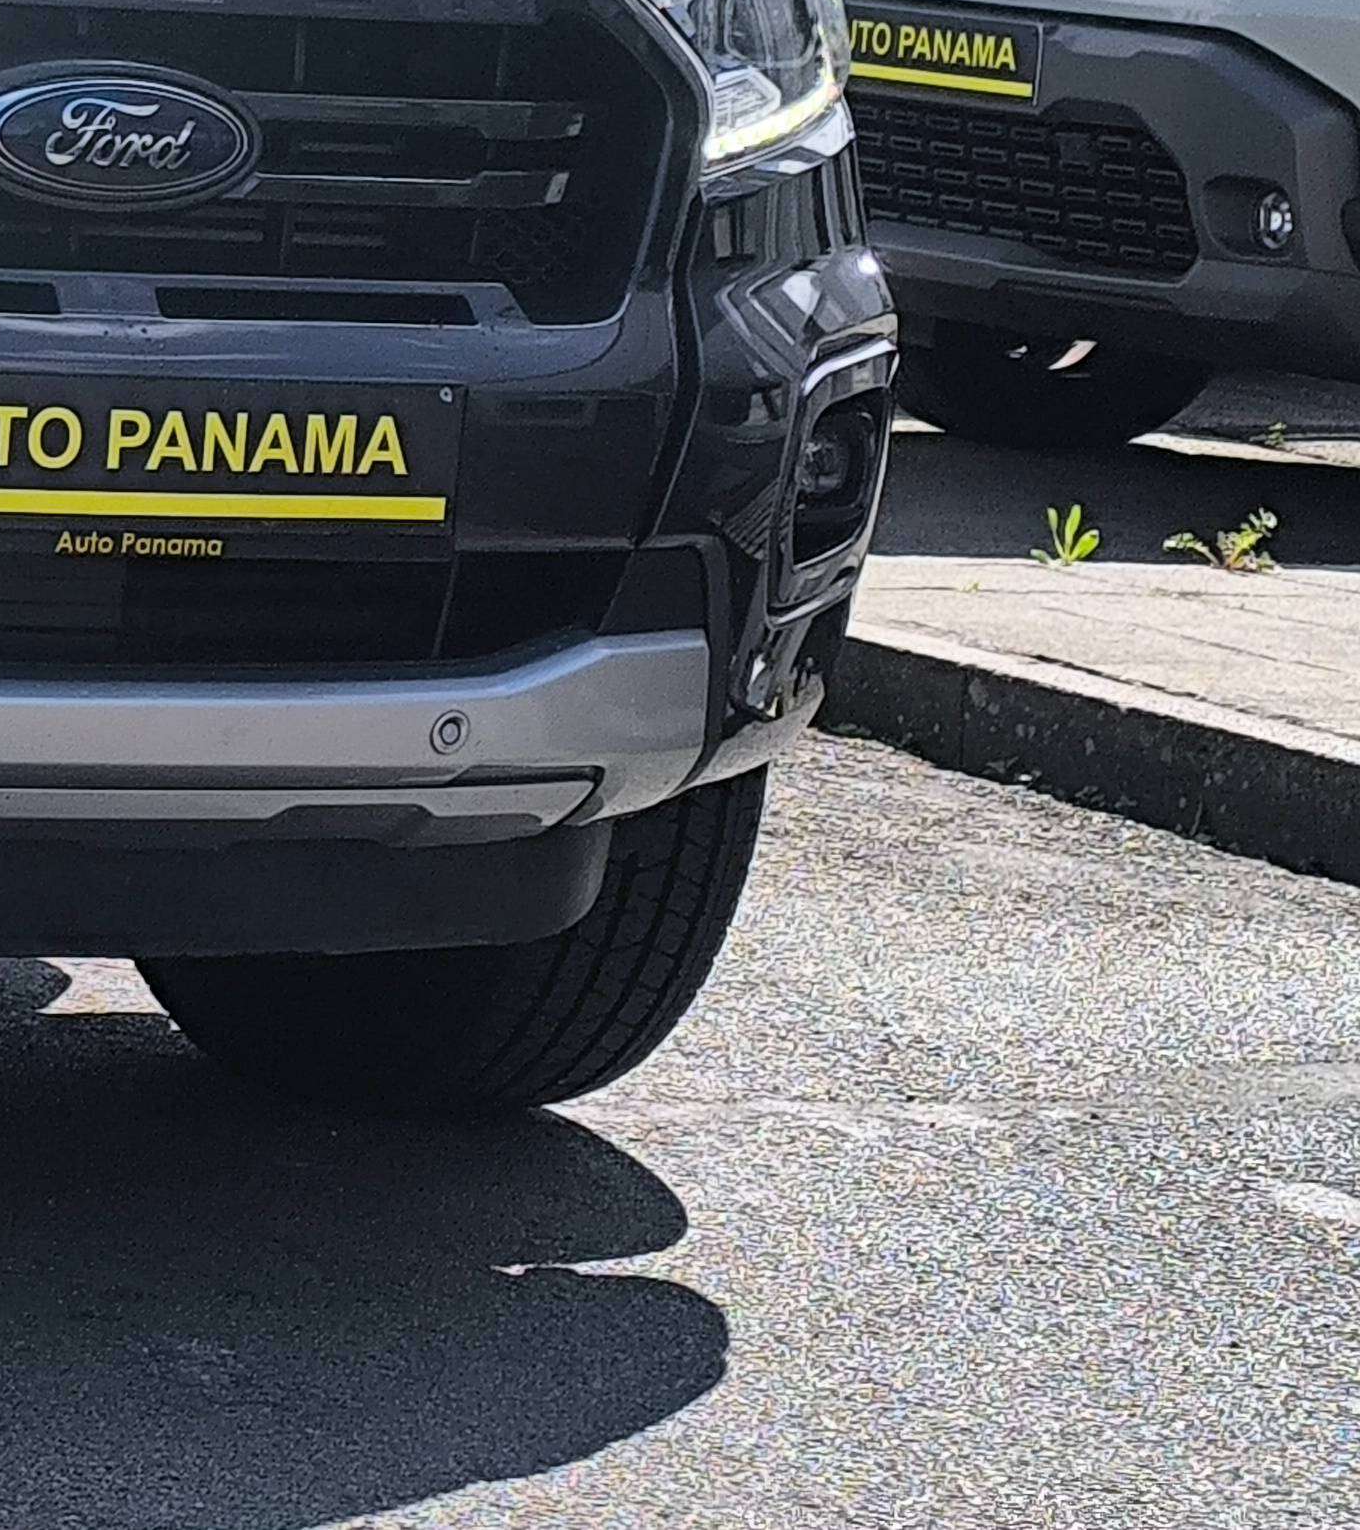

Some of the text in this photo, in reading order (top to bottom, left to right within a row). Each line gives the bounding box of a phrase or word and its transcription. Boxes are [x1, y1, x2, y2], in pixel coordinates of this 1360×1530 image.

[897, 24, 1017, 71] PANAMA
[45, 97, 197, 169] Ford
[106, 408, 409, 476] PANAMA
[54, 530, 223, 557] Auto Panama
